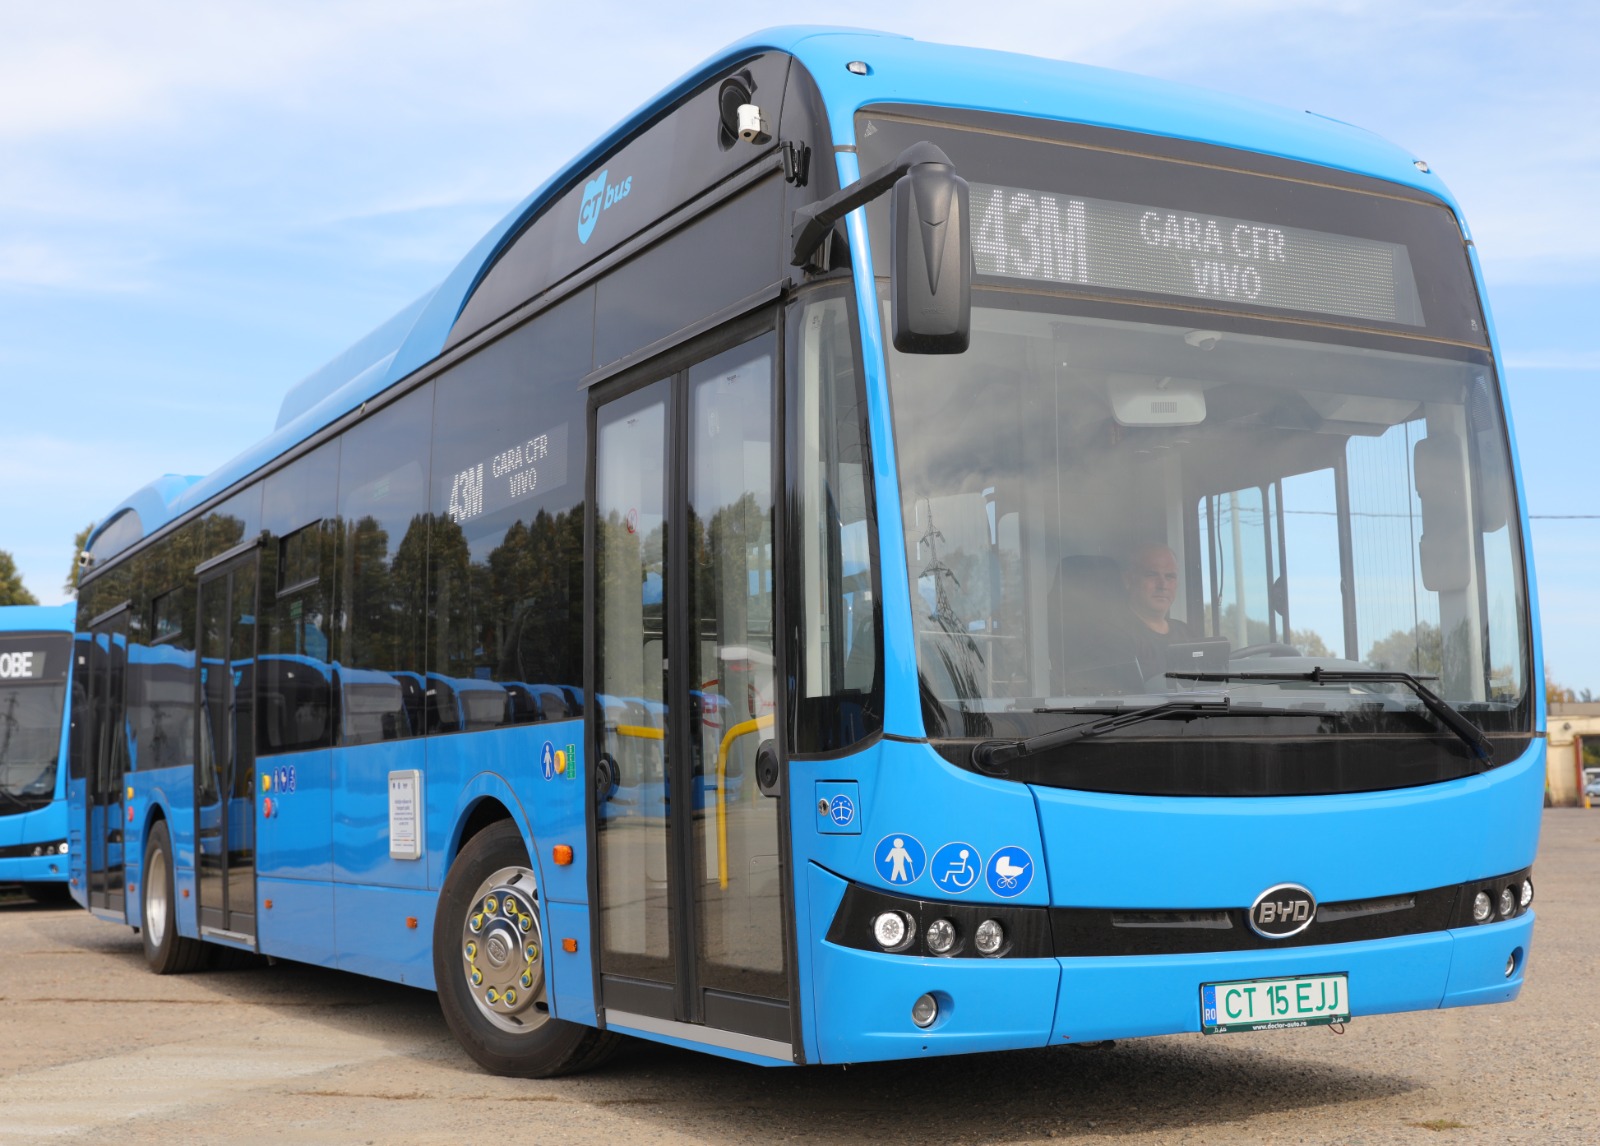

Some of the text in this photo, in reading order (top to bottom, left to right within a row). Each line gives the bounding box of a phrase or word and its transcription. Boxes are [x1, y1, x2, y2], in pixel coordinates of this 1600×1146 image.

[603, 175, 632, 211] bus
[977, 189, 1088, 283] 43M
[1140, 211, 1286, 262] GARA CFR
[1191, 259, 1261, 299] VIVO
[492, 434, 548, 478] GARA CFR
[449, 463, 483, 523] 43M
[509, 467, 537, 498] VIVO
[0, 651, 33, 678] OBE
[1258, 900, 1309, 923] BYD
[1205, 1008, 1217, 1021] RO
[1225, 981, 1338, 1019] CT 15 EJJ
[1252, 1021, 1307, 1031] www.doctor-auto.ro
